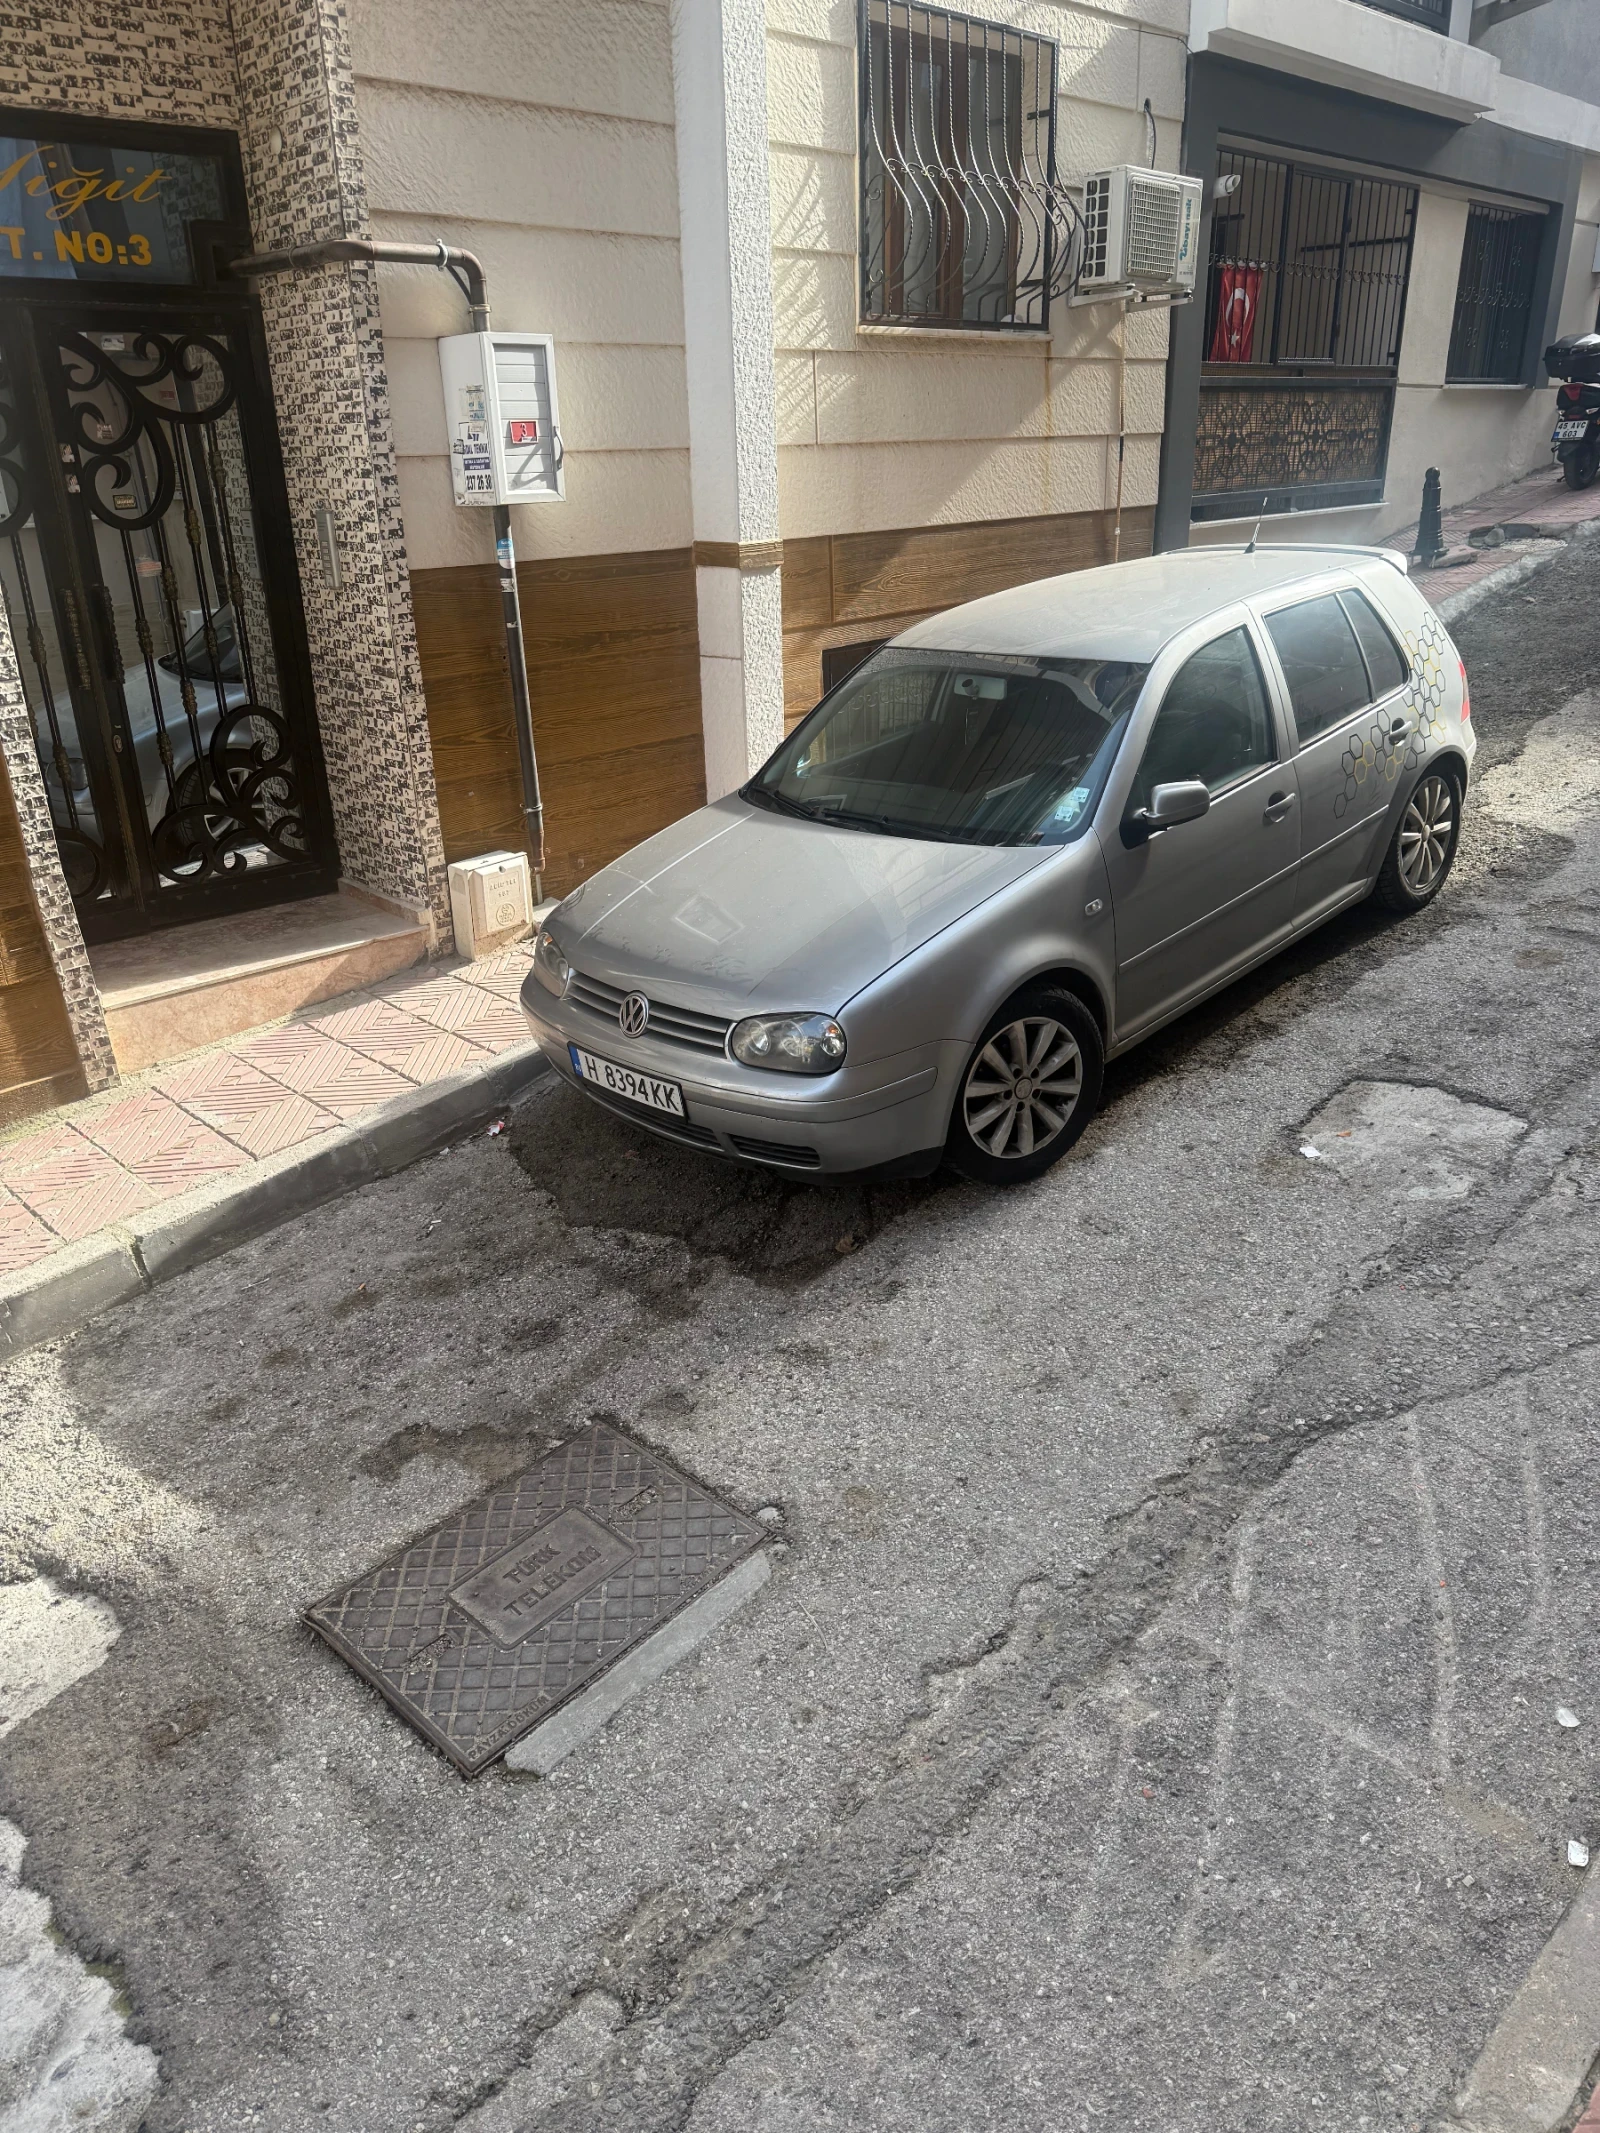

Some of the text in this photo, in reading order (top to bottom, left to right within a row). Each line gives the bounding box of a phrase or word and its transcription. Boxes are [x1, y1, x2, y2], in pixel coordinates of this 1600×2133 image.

[54, 230, 152, 266] NO:3
[1558, 421, 1586, 430] 45 AVC
[1562, 430, 1577, 438] 603
[584, 1055, 599, 1081] H
[503, 1545, 602, 1616] TELEKOM
